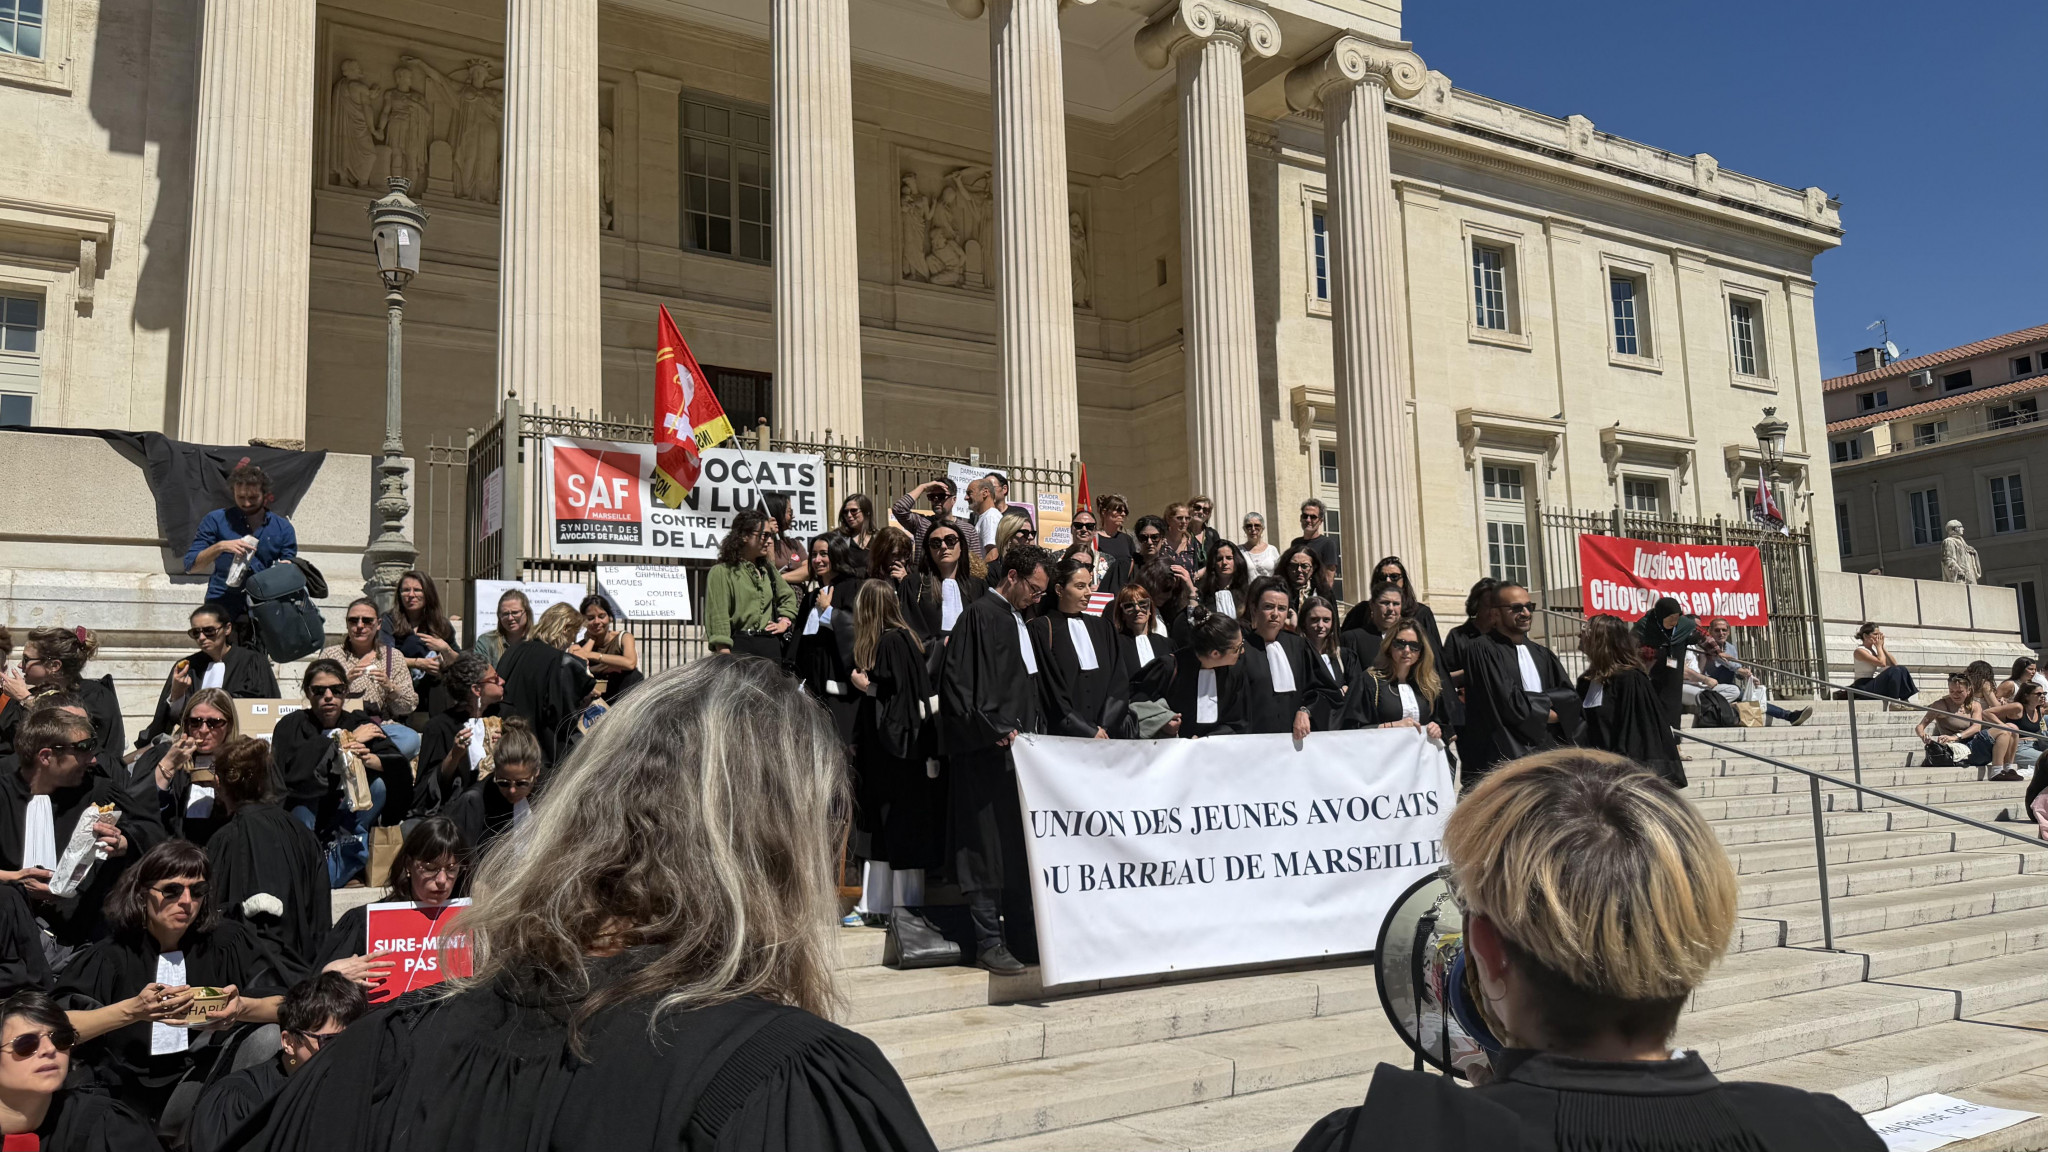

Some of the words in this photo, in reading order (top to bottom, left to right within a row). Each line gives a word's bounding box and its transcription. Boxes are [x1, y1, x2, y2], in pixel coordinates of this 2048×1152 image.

[650, 458, 815, 487] OCATS
[568, 474, 629, 509] SAF
[592, 512, 631, 520] MARSEILLE
[651, 513, 716, 528] CONTRE
[560, 523, 614, 533] SYNDICAT
[560, 532, 595, 540] AVOCATS
[609, 534, 639, 542] FRANCE
[652, 530, 684, 547] DE
[691, 532, 721, 549] LA
[635, 571, 685, 579] CRIMINELLES
[1685, 551, 1740, 581] bradée
[1691, 591, 1711, 616] en
[1712, 588, 1760, 620] danger
[1029, 811, 1127, 838] UNION
[1131, 807, 1182, 836] DES
[1191, 801, 1298, 835] JEUNES
[1307, 790, 1438, 824] AVOCATS
[1078, 857, 1216, 892] BARREAU
[1224, 854, 1265, 881] DE
[1272, 839, 1445, 878] MARSEILLE
[374, 935, 466, 952] SURE-MNT
[404, 957, 437, 972] PAS
